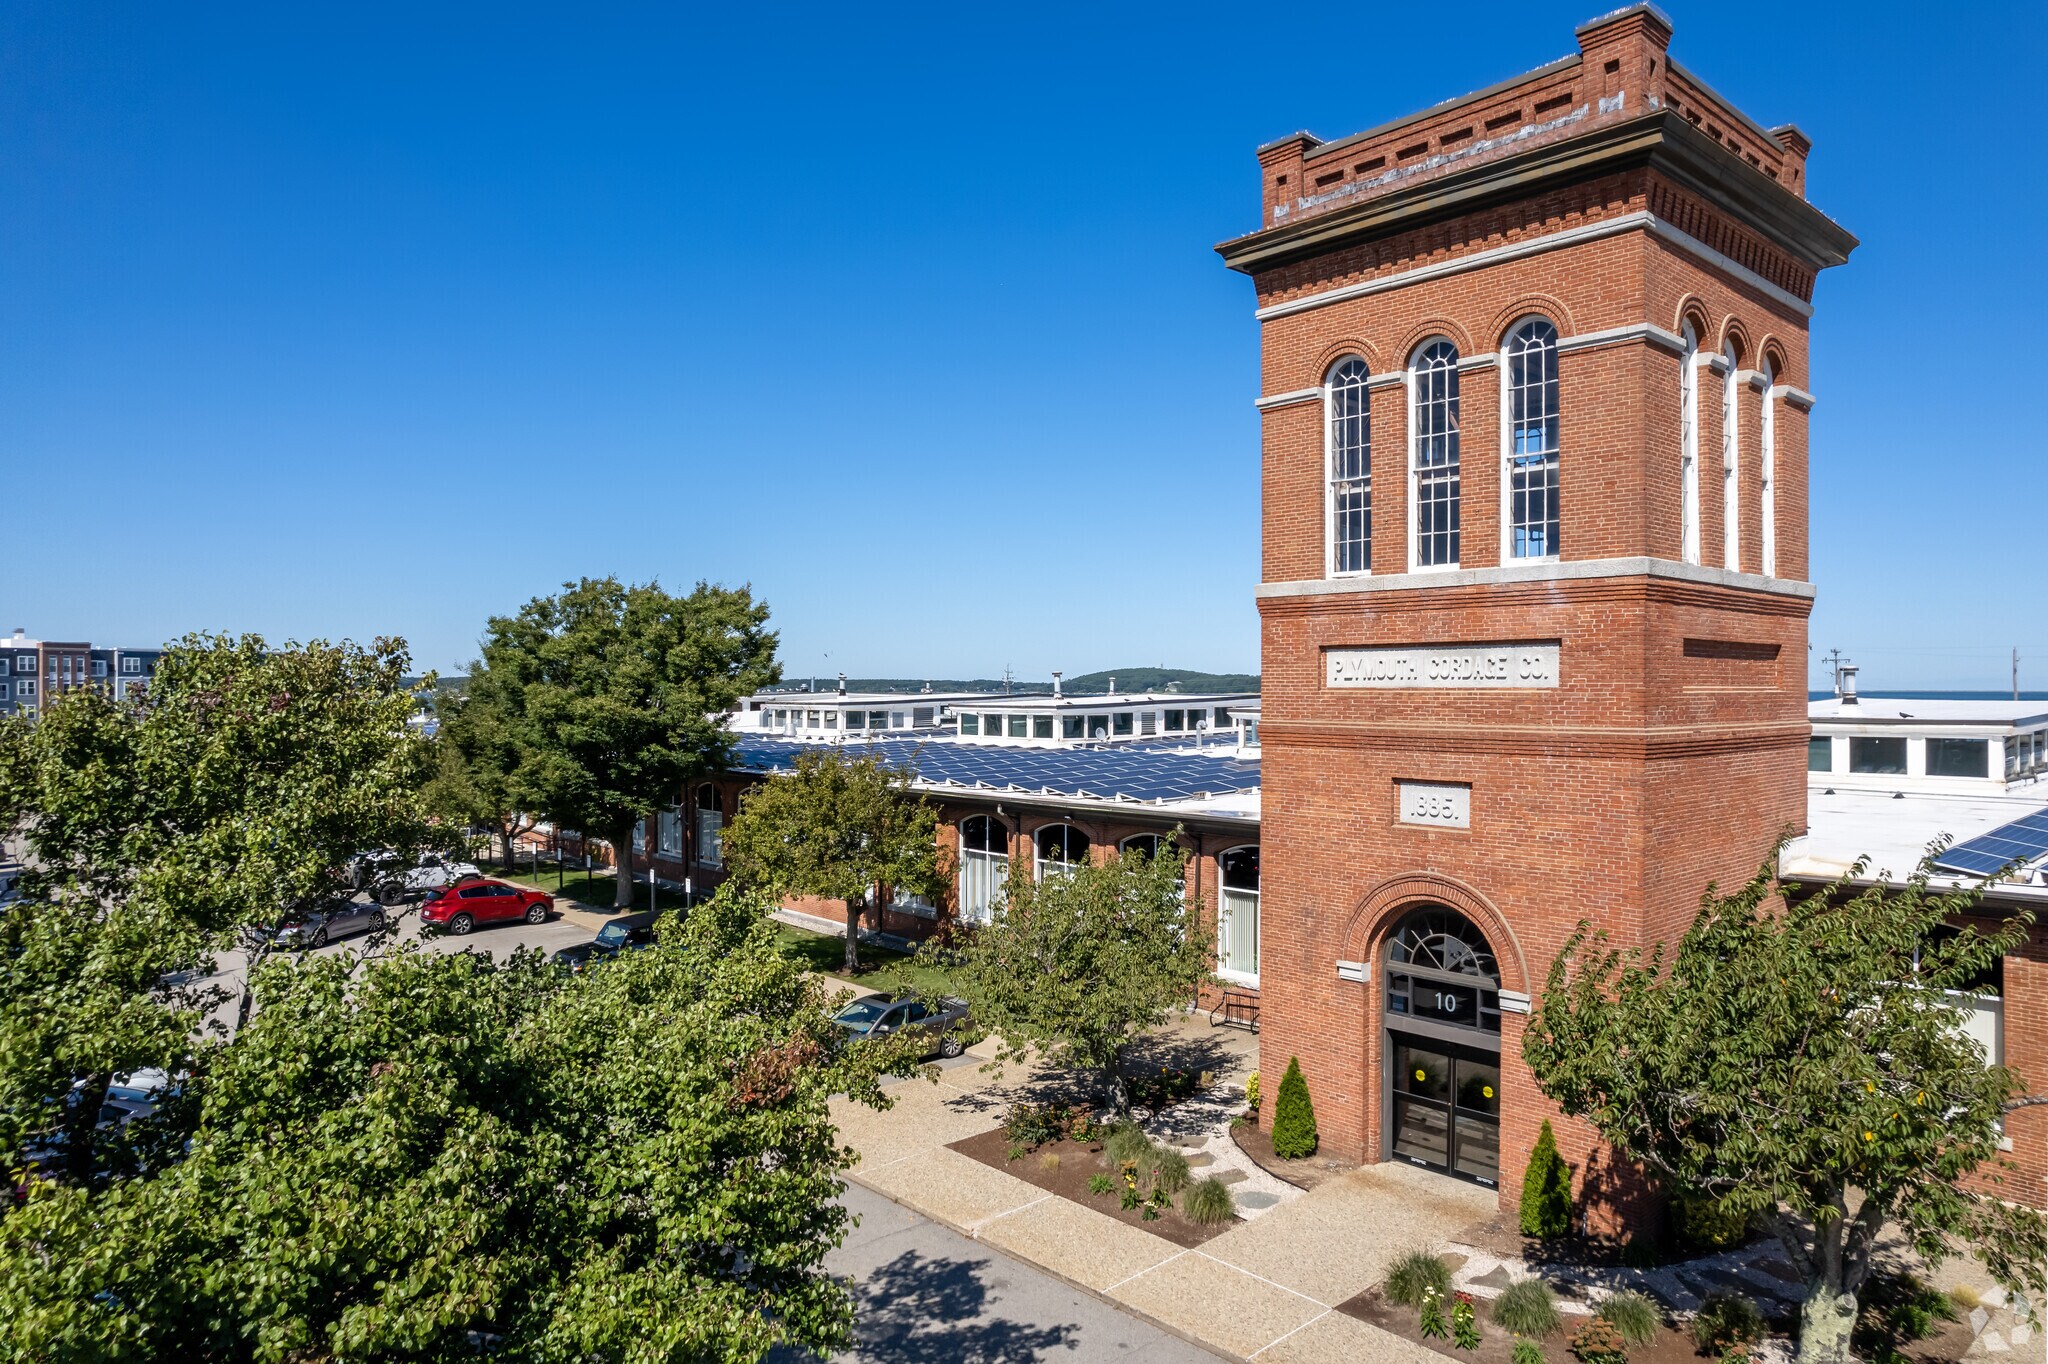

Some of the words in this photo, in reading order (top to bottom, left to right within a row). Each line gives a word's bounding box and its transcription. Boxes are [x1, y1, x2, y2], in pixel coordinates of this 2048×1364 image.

[1334, 657, 1418, 681] PLYMOUTH
[1429, 656, 1507, 680] CORDAGE
[1519, 655, 1548, 680] CO.
[1435, 992, 1456, 1013] 10
